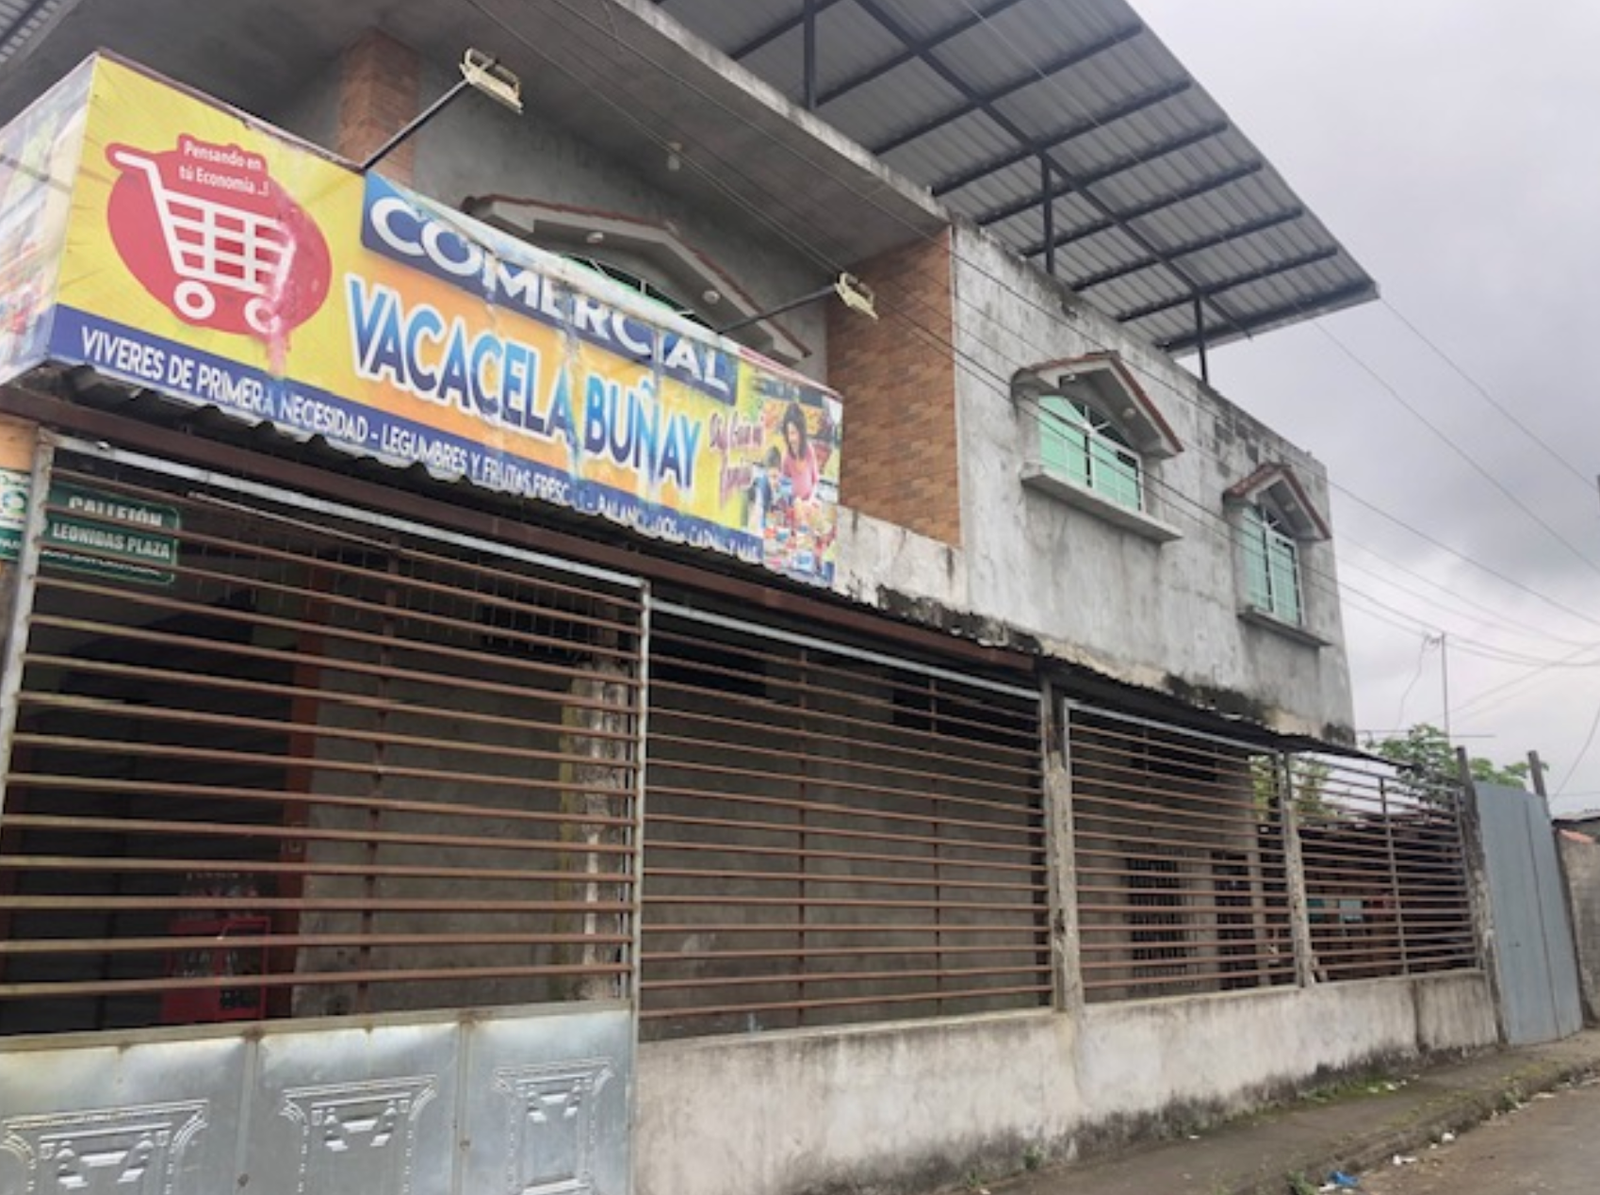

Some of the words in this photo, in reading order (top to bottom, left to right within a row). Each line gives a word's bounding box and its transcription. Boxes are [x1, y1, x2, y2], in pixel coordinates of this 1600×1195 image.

[184, 140, 245, 167] Pensando
[247, 157, 262, 171] en
[370, 196, 730, 394] COMERCIAL
[82, 326, 165, 380] VIVERES
[168, 355, 195, 389] DE
[196, 363, 274, 416] PRIMERA
[278, 391, 368, 443] NECESIDAD
[382, 424, 467, 475] LEGUMBRES
[470, 453, 482, 482] Y
[345, 274, 579, 447] VACACELA
[583, 372, 701, 490] BUÑAY
[52, 523, 124, 551] LEONIDAS
[127, 536, 170, 559] PLAZA
